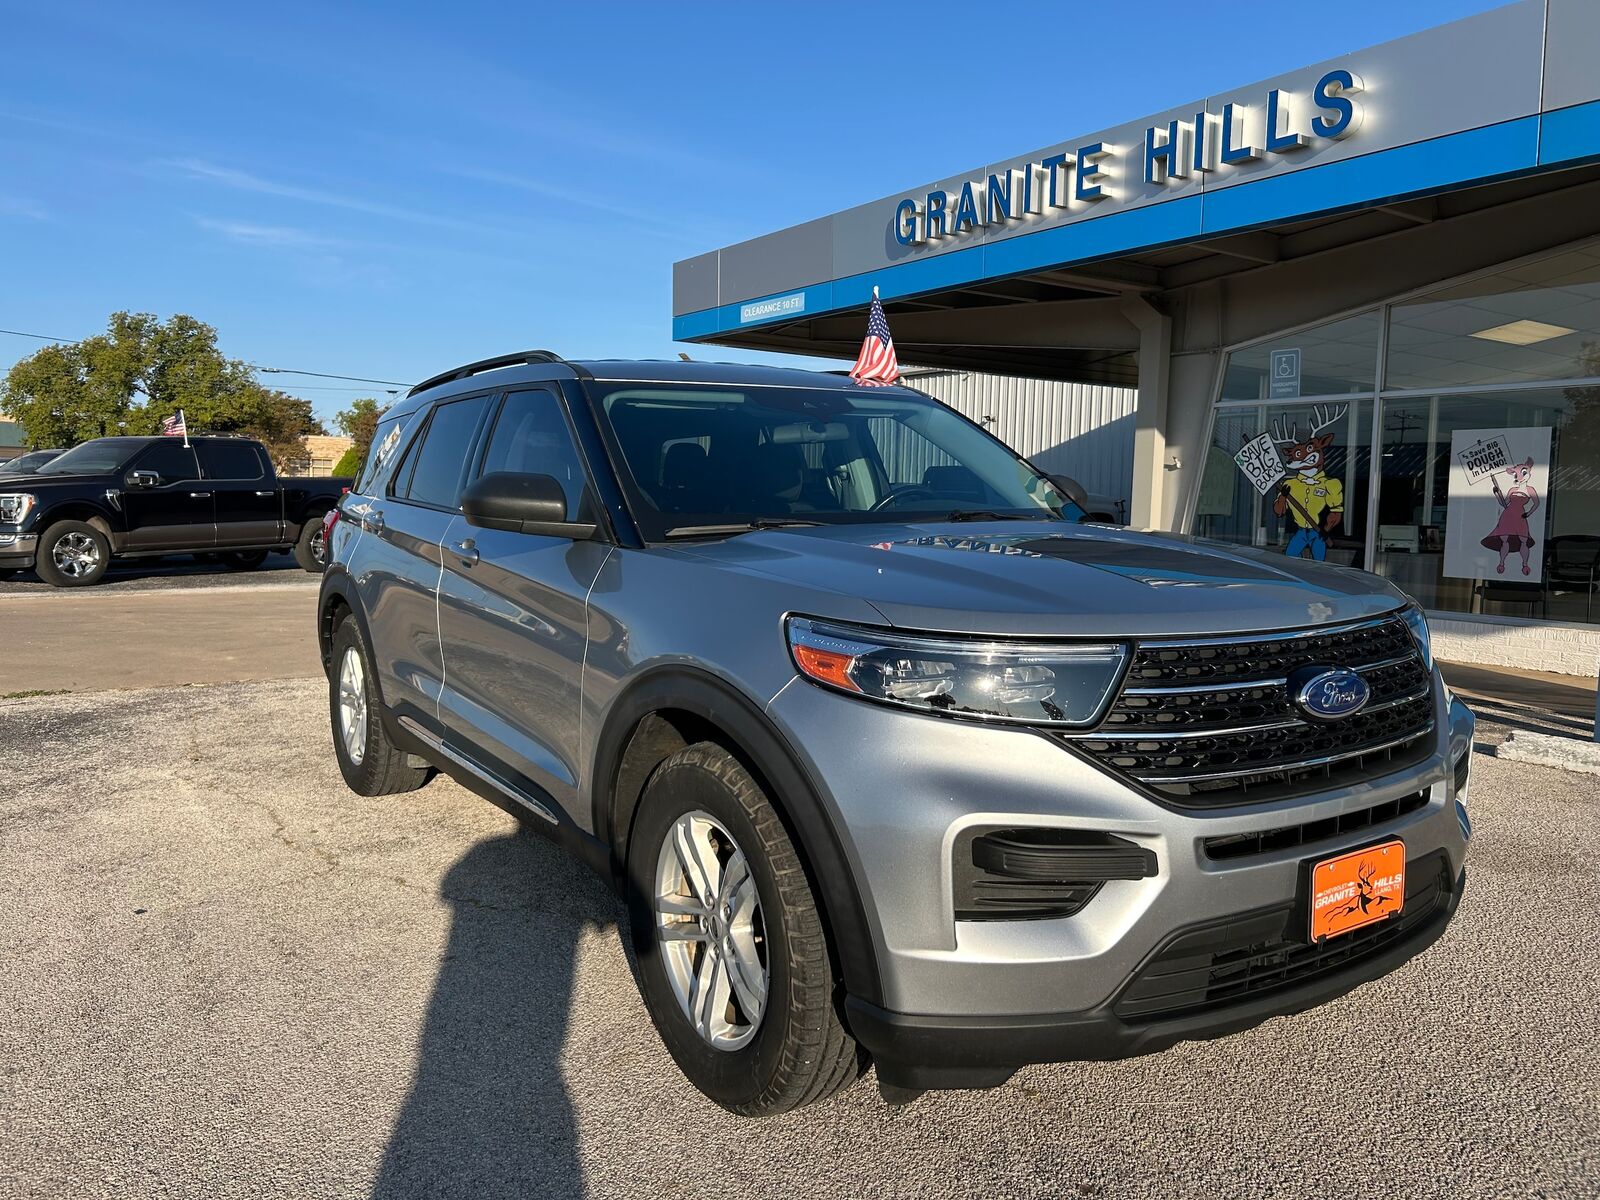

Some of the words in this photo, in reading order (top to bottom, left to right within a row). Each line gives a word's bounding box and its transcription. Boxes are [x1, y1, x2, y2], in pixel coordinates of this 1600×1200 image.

[893, 142, 1106, 246] GRANITE
[1145, 69, 1357, 185] HILLS
[744, 301, 782, 317] CLEARANCE
[782, 300, 790, 310] 10
[1241, 436, 1271, 463] SAVE
[1466, 447, 1504, 471] DOUGH
[1469, 447, 1486, 458] Save
[1486, 441, 1499, 451] BIG
[1246, 450, 1275, 478] BIG
[1256, 461, 1284, 491] BUCKS
[1480, 457, 1508, 474] LLANO!
[1321, 681, 1357, 708] Ford
[1373, 873, 1402, 889] HILLS
[1315, 887, 1355, 908] GRANITE
